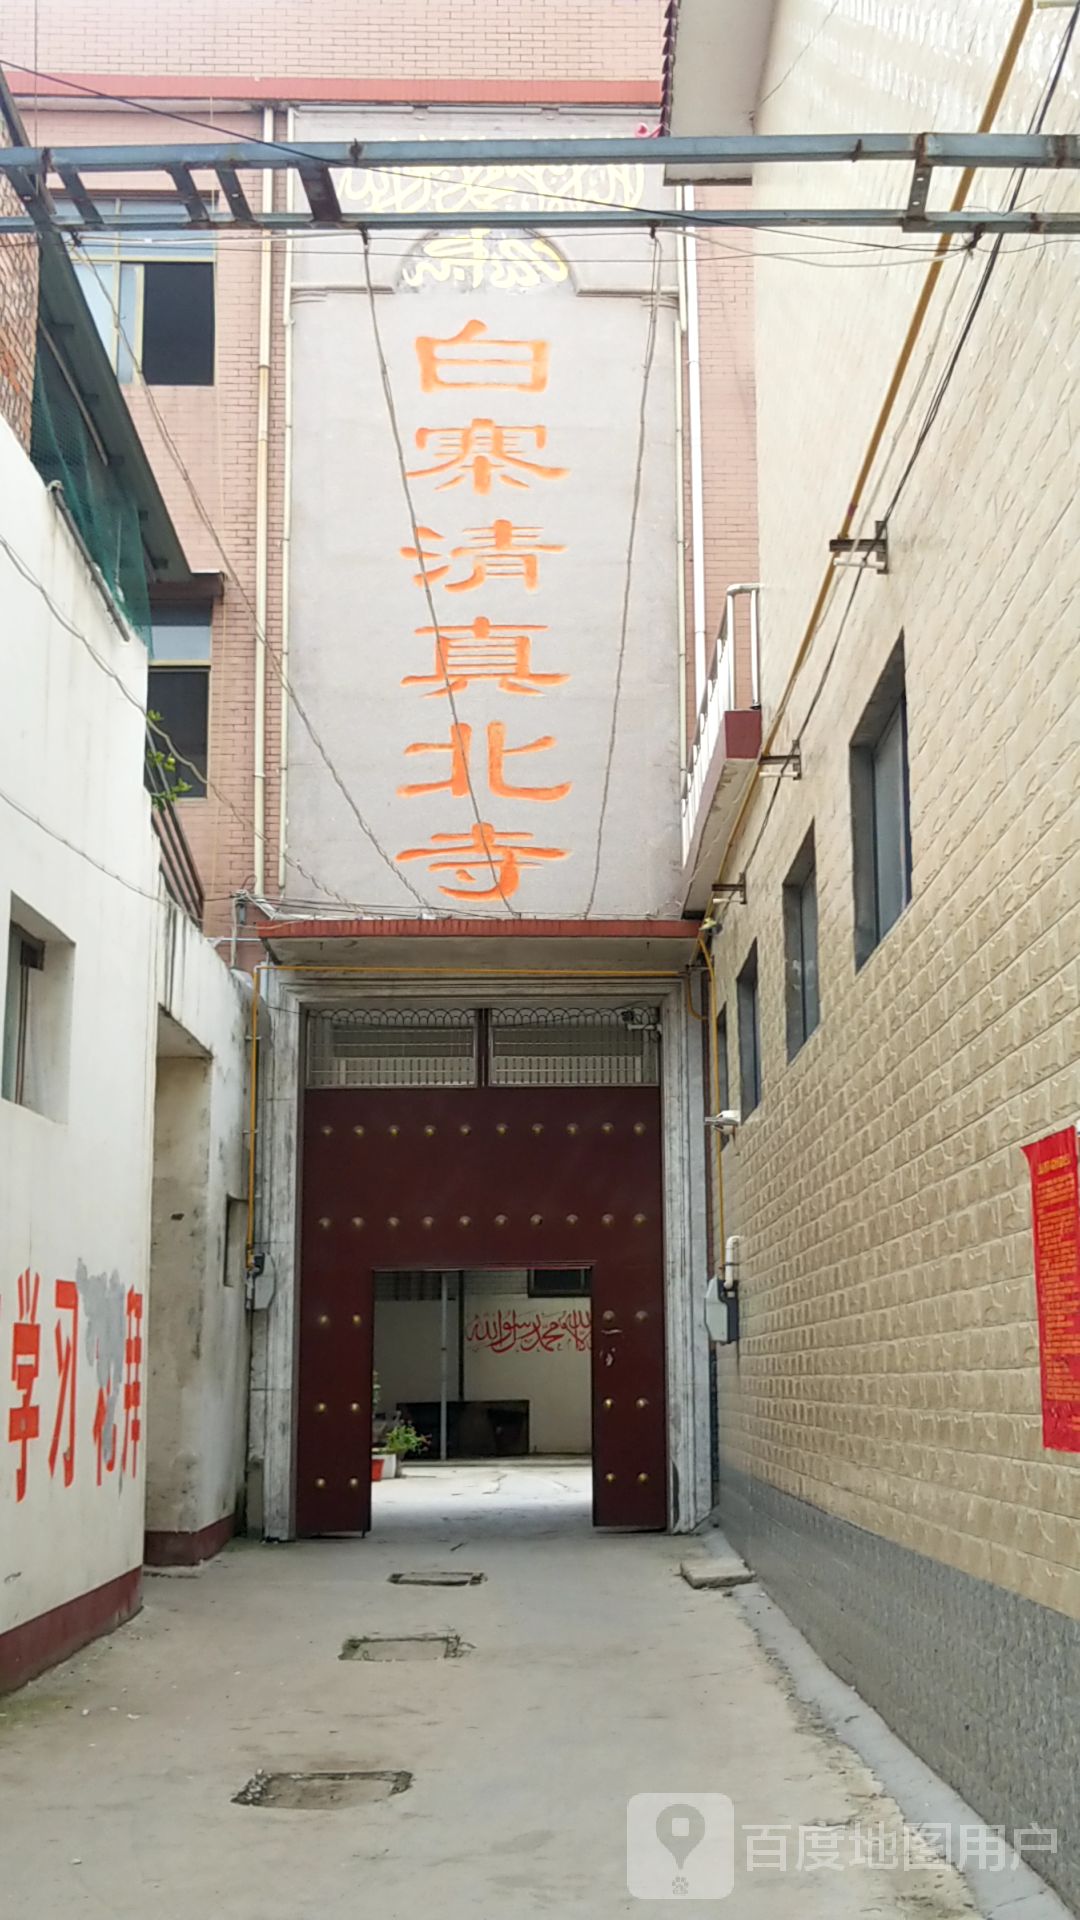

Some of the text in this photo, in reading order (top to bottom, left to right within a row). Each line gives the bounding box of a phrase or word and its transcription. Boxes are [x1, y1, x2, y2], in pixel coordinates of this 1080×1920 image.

[396, 319, 572, 901] 白寨清真北寺
